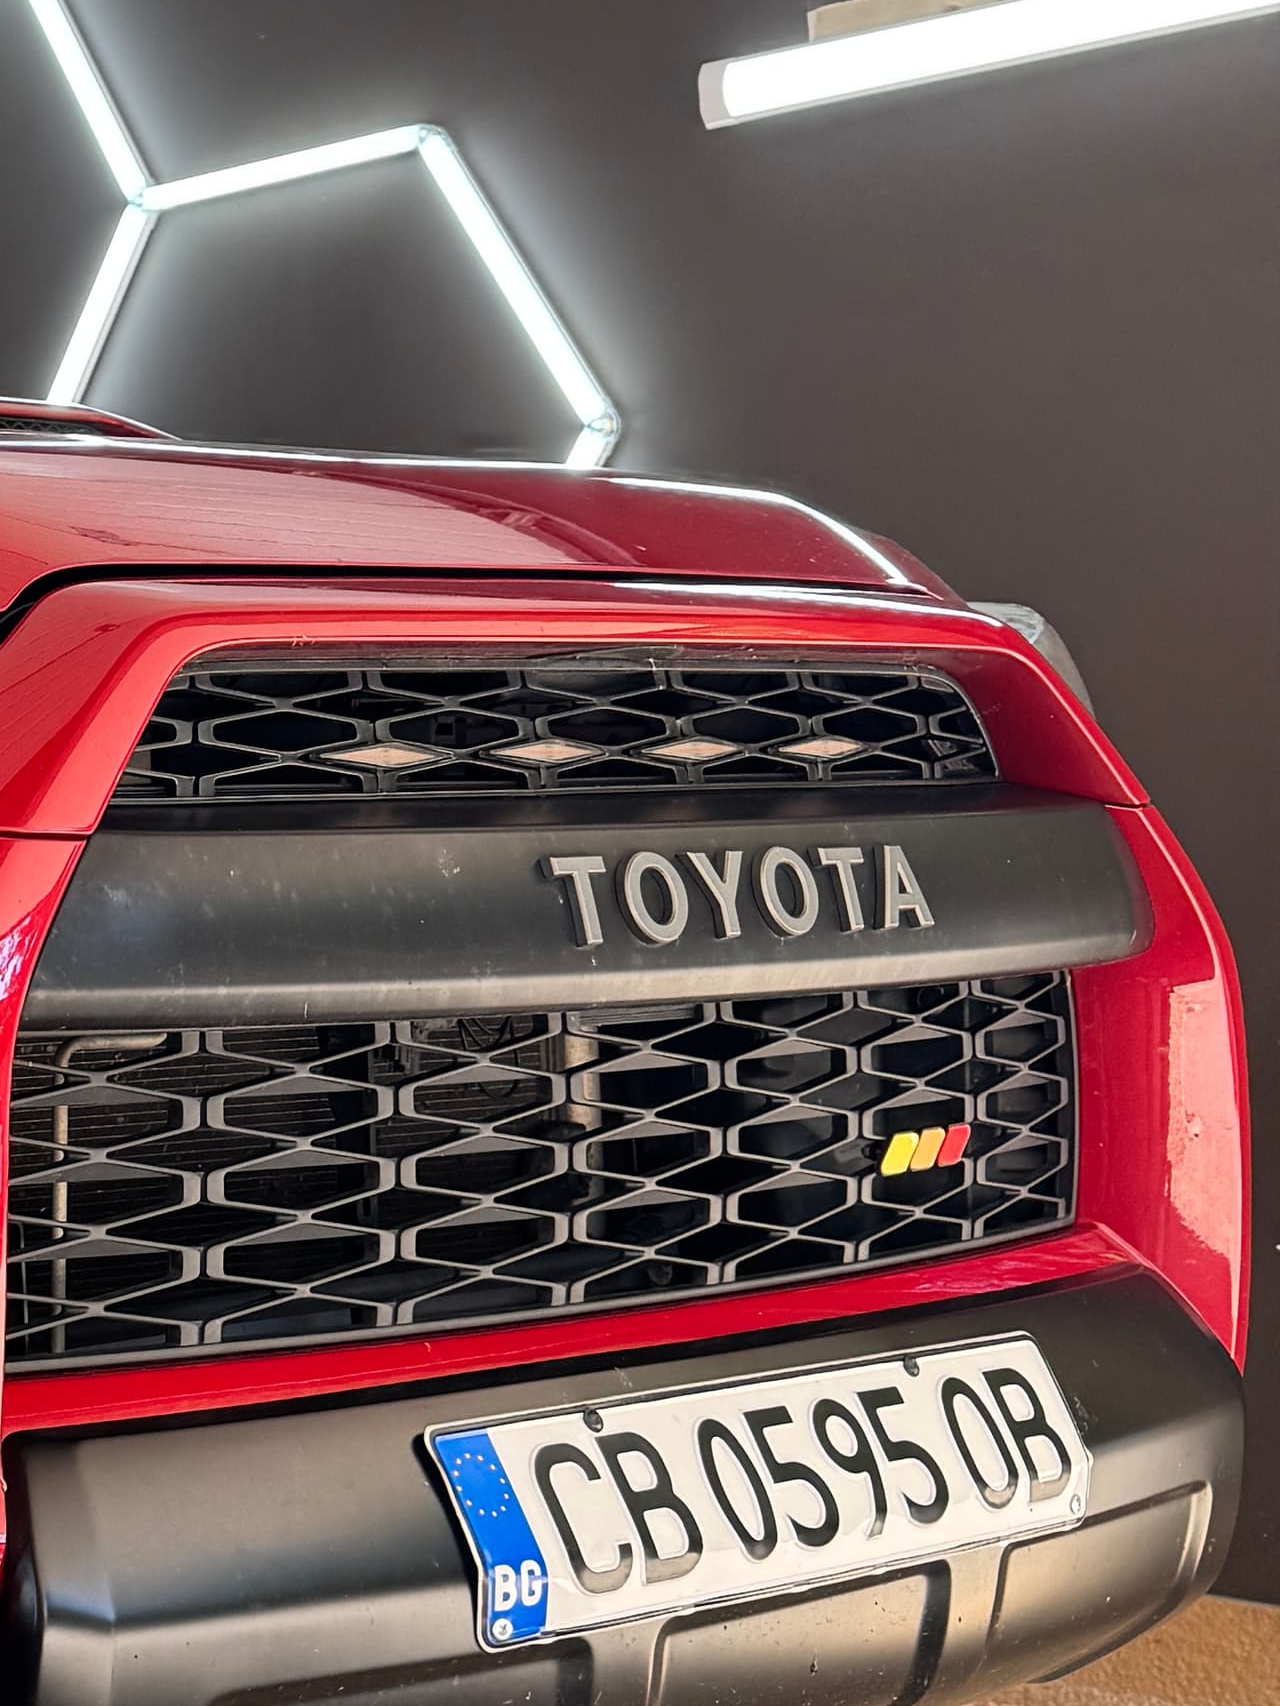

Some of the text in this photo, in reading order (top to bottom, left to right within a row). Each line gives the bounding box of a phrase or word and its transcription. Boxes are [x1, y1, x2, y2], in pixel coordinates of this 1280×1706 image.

[542, 845, 935, 946] TOYOTA
[534, 1367, 1072, 1594] CB 0595 OB
[493, 1559, 544, 1612] BG
